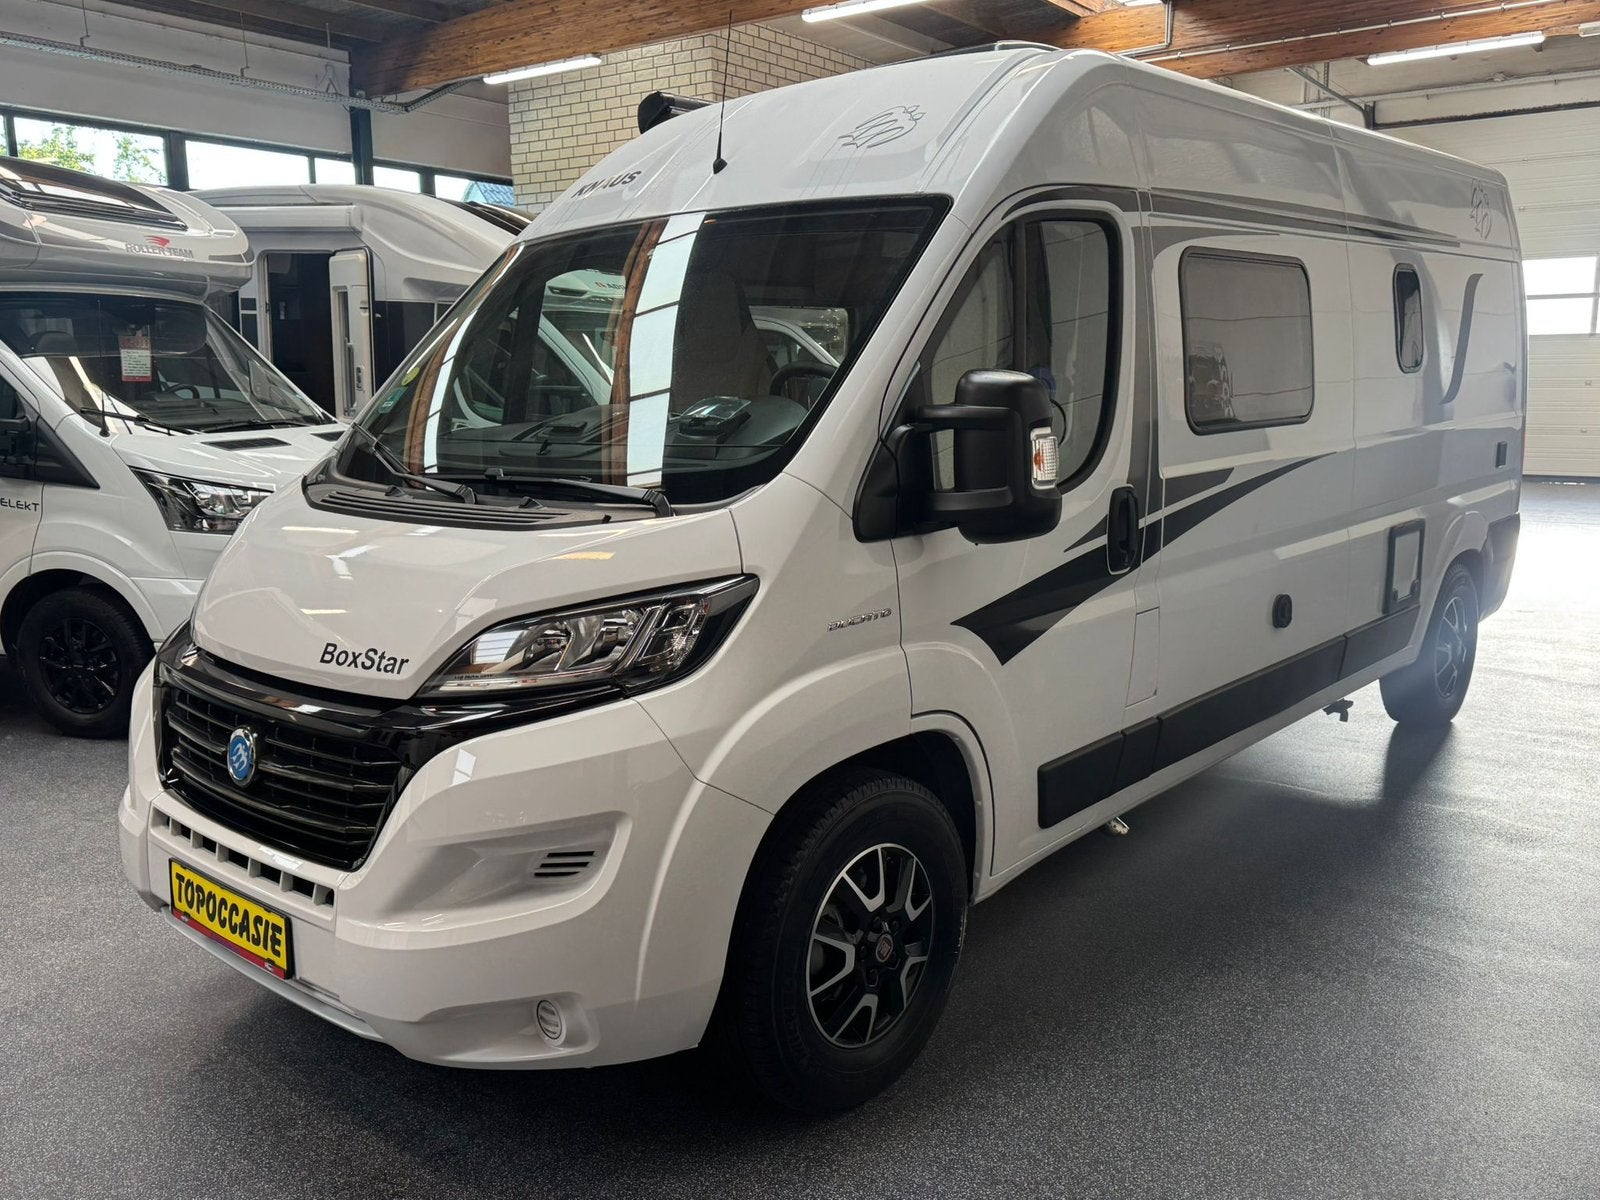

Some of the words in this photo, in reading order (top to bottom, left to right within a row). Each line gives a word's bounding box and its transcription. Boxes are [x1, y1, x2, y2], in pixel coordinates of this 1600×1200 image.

[125, 243, 167, 256] ROLLER
[167, 247, 195, 259] TEAM
[0, 497, 40, 512] ELEKT
[319, 642, 410, 675] BoxStar
[175, 871, 283, 958] TOPOCCASIE
